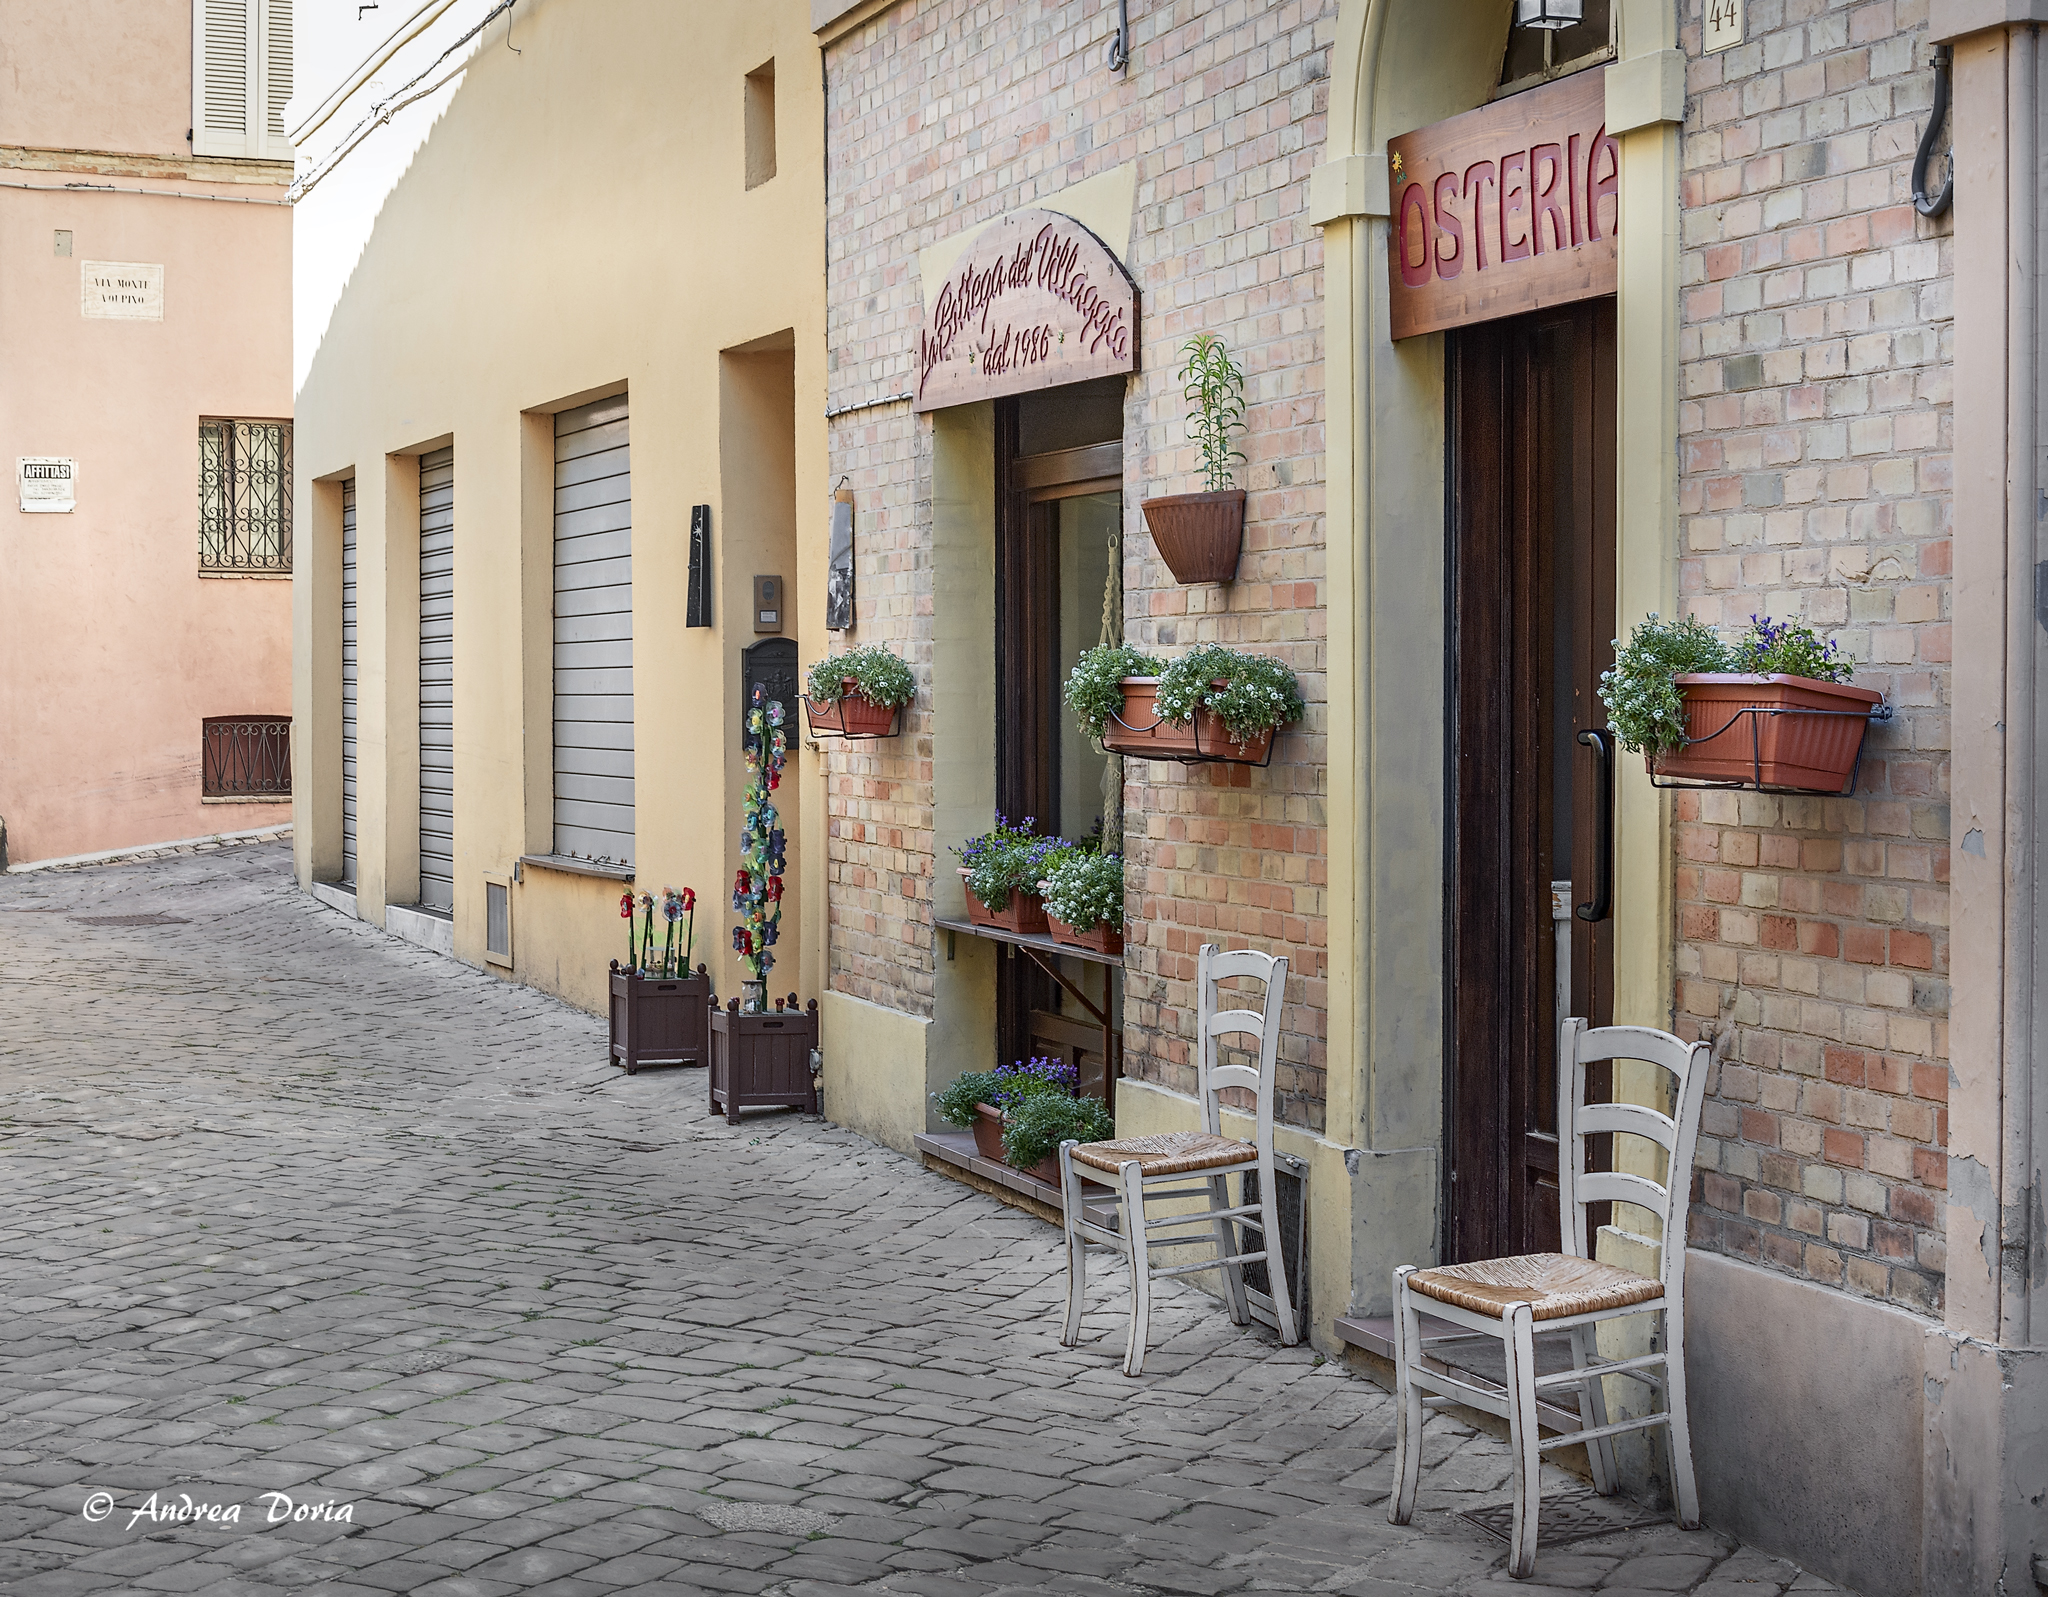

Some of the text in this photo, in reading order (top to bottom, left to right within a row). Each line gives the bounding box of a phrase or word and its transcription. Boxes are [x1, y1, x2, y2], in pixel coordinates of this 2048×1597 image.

[1709, 0, 1737, 32] 44
[1400, 122, 1619, 288] OSTERIA
[94, 278, 111, 288] VIA
[919, 222, 1128, 401] La Bottega del Villaggio
[983, 324, 1049, 376] dal 1986
[24, 464, 71, 479] AFFITTASI
